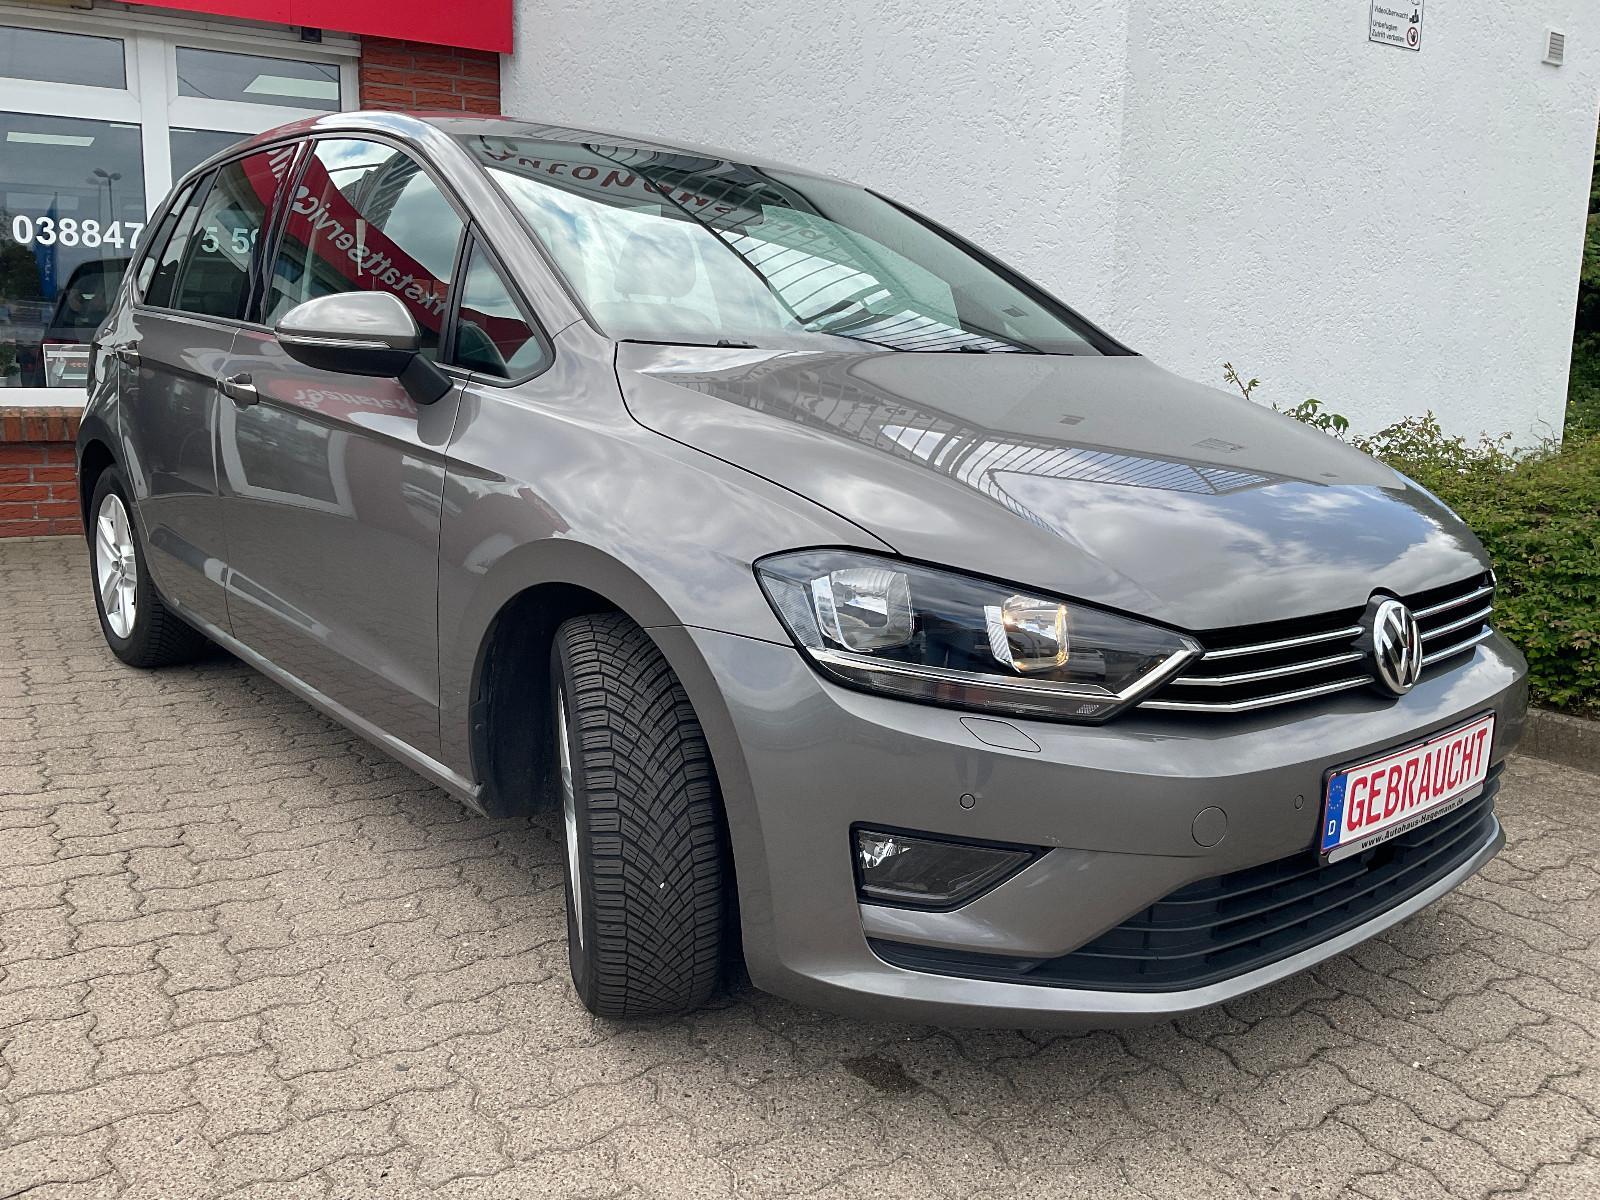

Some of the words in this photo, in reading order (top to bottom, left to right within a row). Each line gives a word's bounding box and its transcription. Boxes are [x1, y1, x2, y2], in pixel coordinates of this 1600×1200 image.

[12, 214, 144, 249] 038847
[201, 226, 219, 253] 5
[1346, 727, 1488, 832] GEBRAUCHT
[1327, 820, 1336, 836] D
[1361, 798, 1464, 849] www.Autohaus-Hagemann.de
